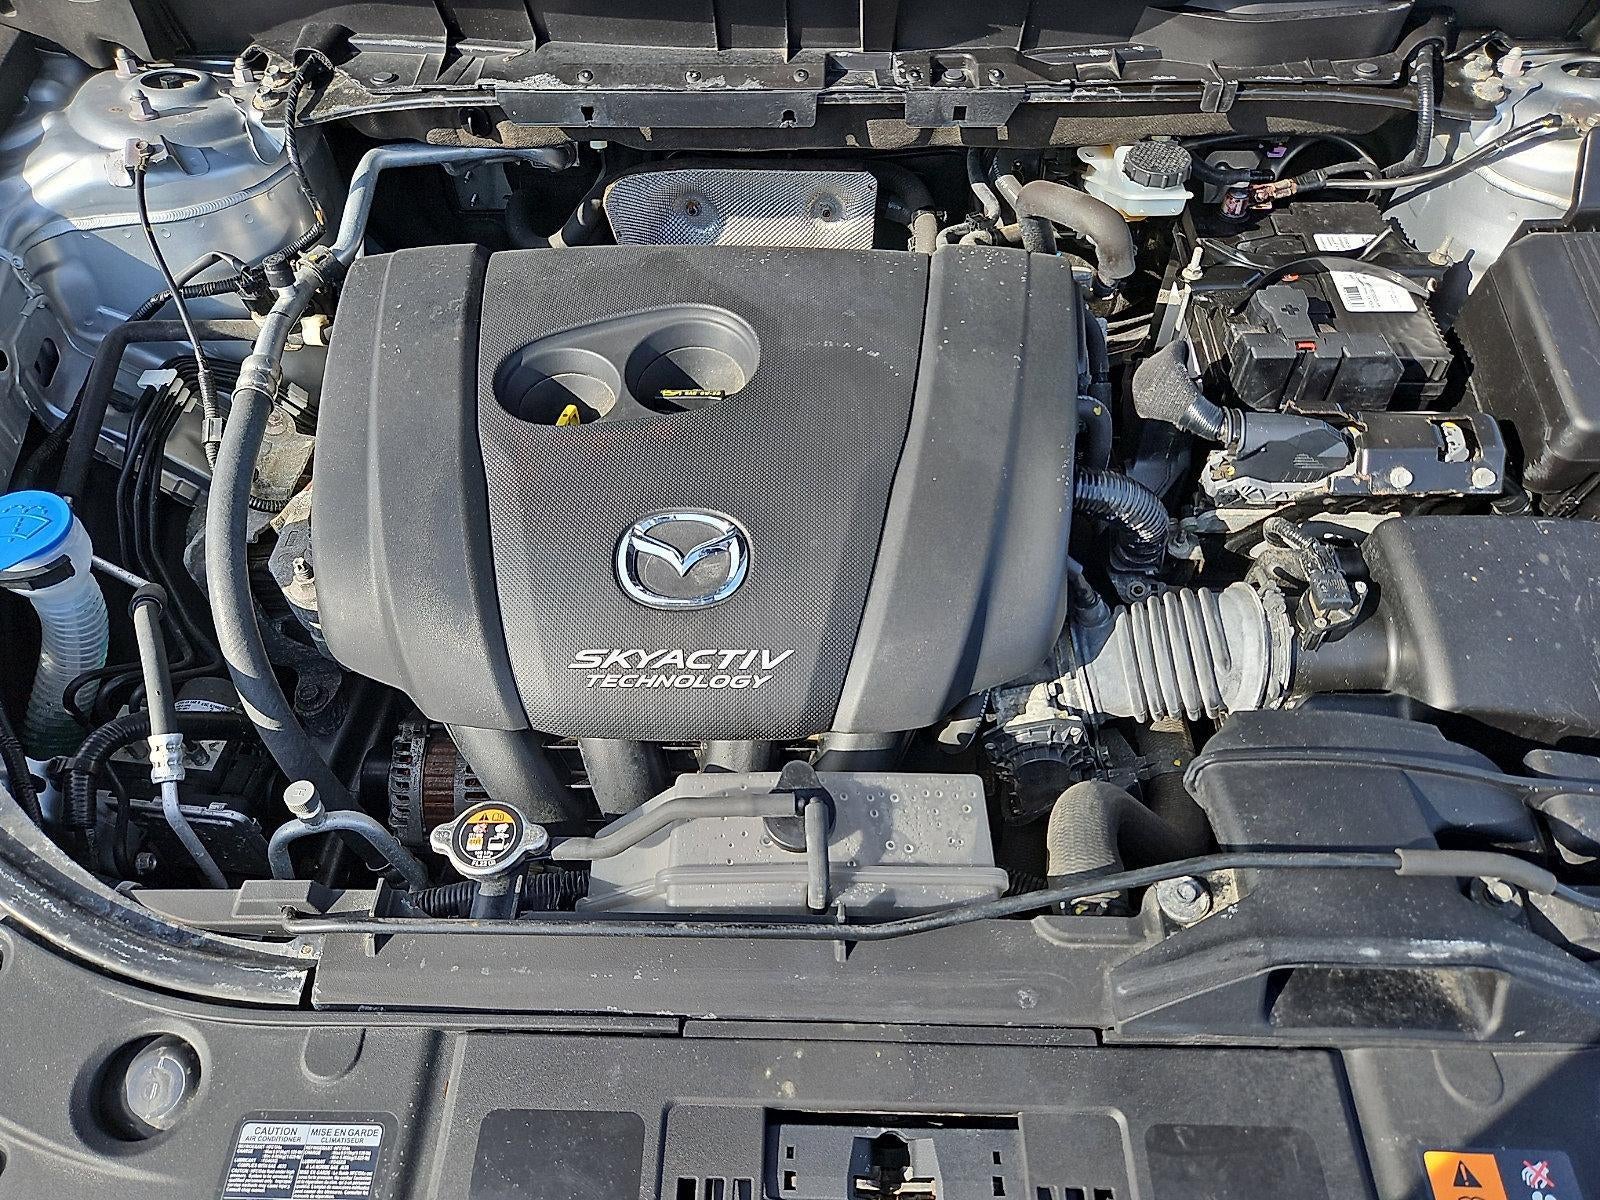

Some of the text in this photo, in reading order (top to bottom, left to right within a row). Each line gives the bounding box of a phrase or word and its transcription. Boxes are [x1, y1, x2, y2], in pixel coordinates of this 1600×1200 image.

[567, 649, 795, 671] SKYACTIV
[586, 673, 775, 689] TECHNOLOGY
[254, 1126, 298, 1136] CAUTION
[310, 1128, 380, 1137] MISE EN GARDE
[258, 1135, 302, 1143] CONDITIONER
